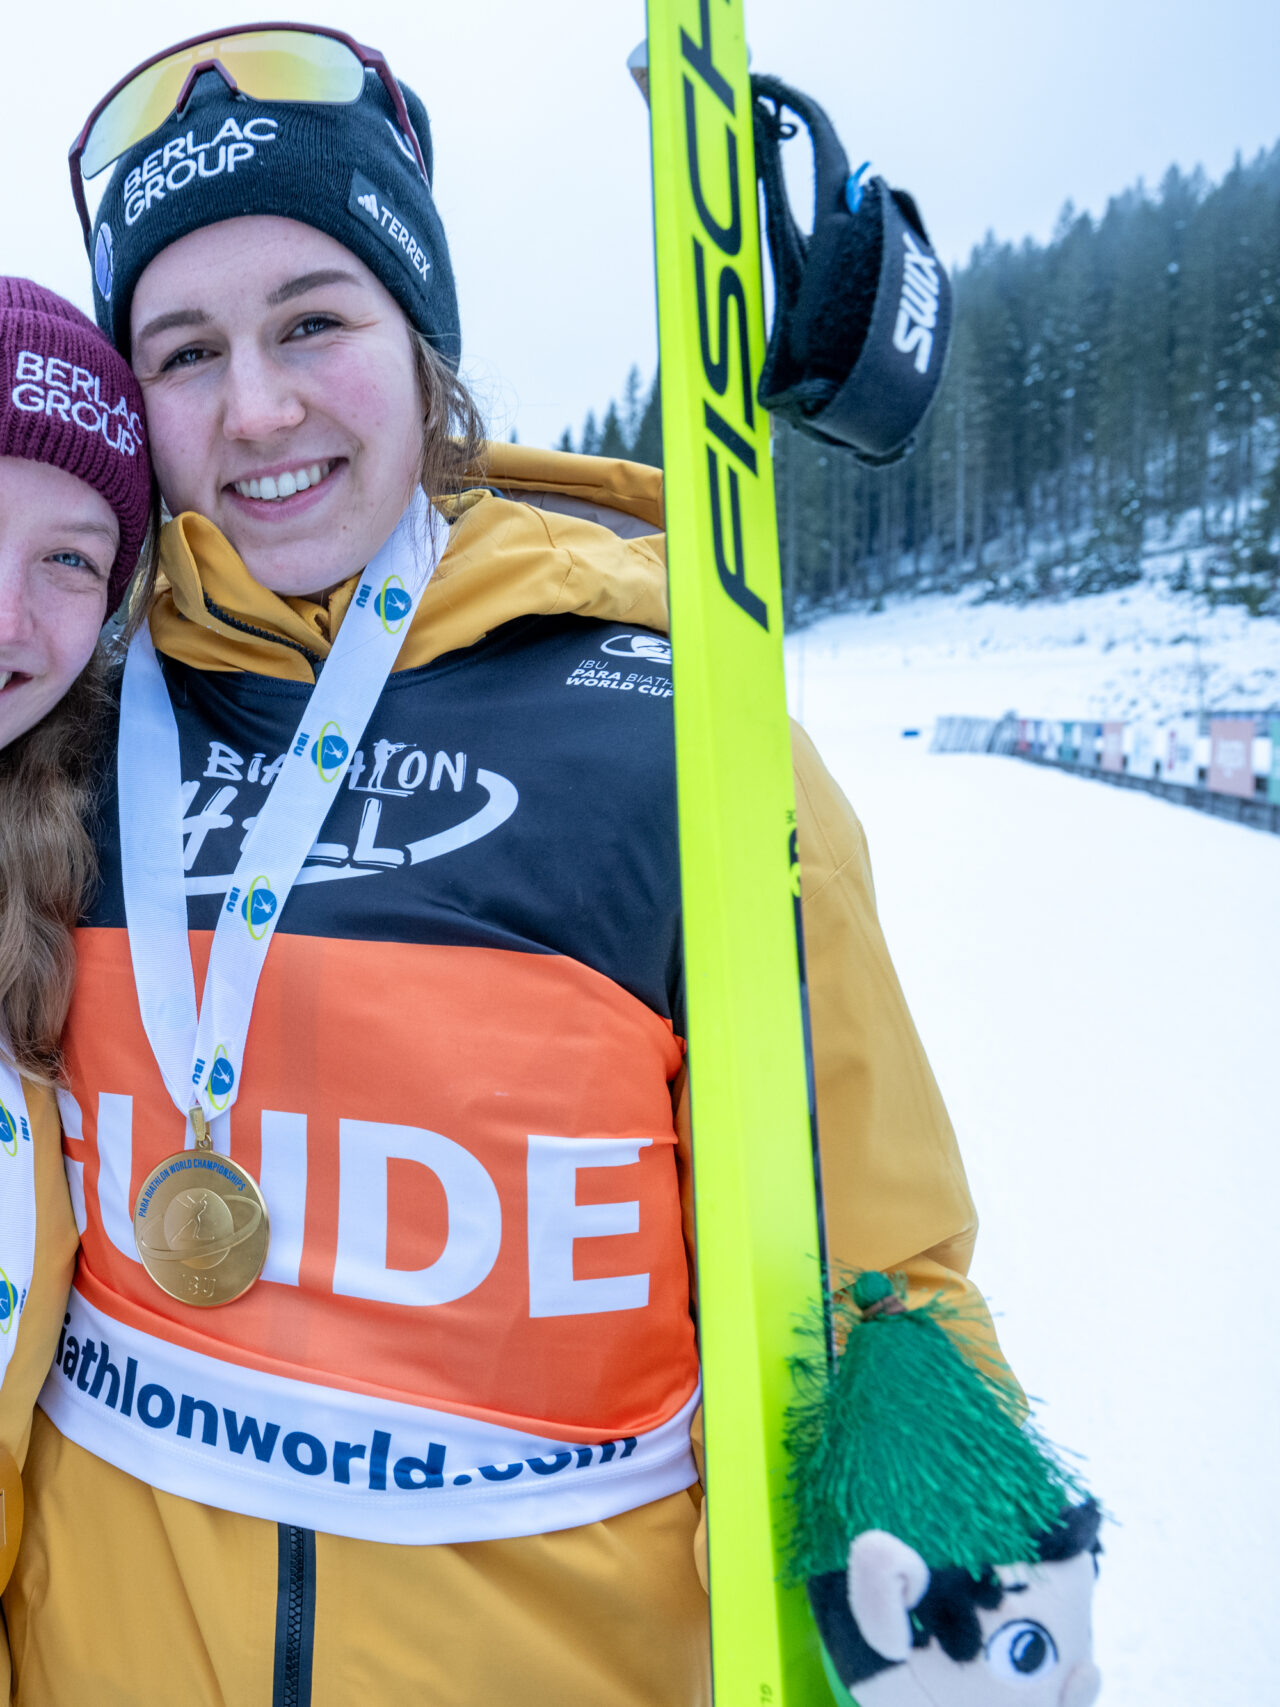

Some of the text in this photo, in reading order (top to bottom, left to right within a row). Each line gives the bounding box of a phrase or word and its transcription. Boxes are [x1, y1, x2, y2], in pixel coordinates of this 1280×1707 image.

[123, 117, 278, 202] BERLAC
[124, 142, 255, 226] GROUP
[380, 206, 431, 282] TERREX
[893, 231, 941, 375] SWIX
[15, 350, 143, 446] BERLAC
[11, 383, 136, 457] GROUP
[355, 583, 373, 609] IBU
[571, 668, 622, 681] PARA
[578, 659, 609, 670] IBU
[565, 677, 675, 698] WORLD CUP
[292, 731, 310, 758] IBU
[225, 886, 241, 913] IBU
[192, 1057, 206, 1085] IBU
[19, 1115, 31, 1142] IBU
[137, 1158, 247, 1218] PARA BIATHLON WORLD CHAMPIONSHIPS
